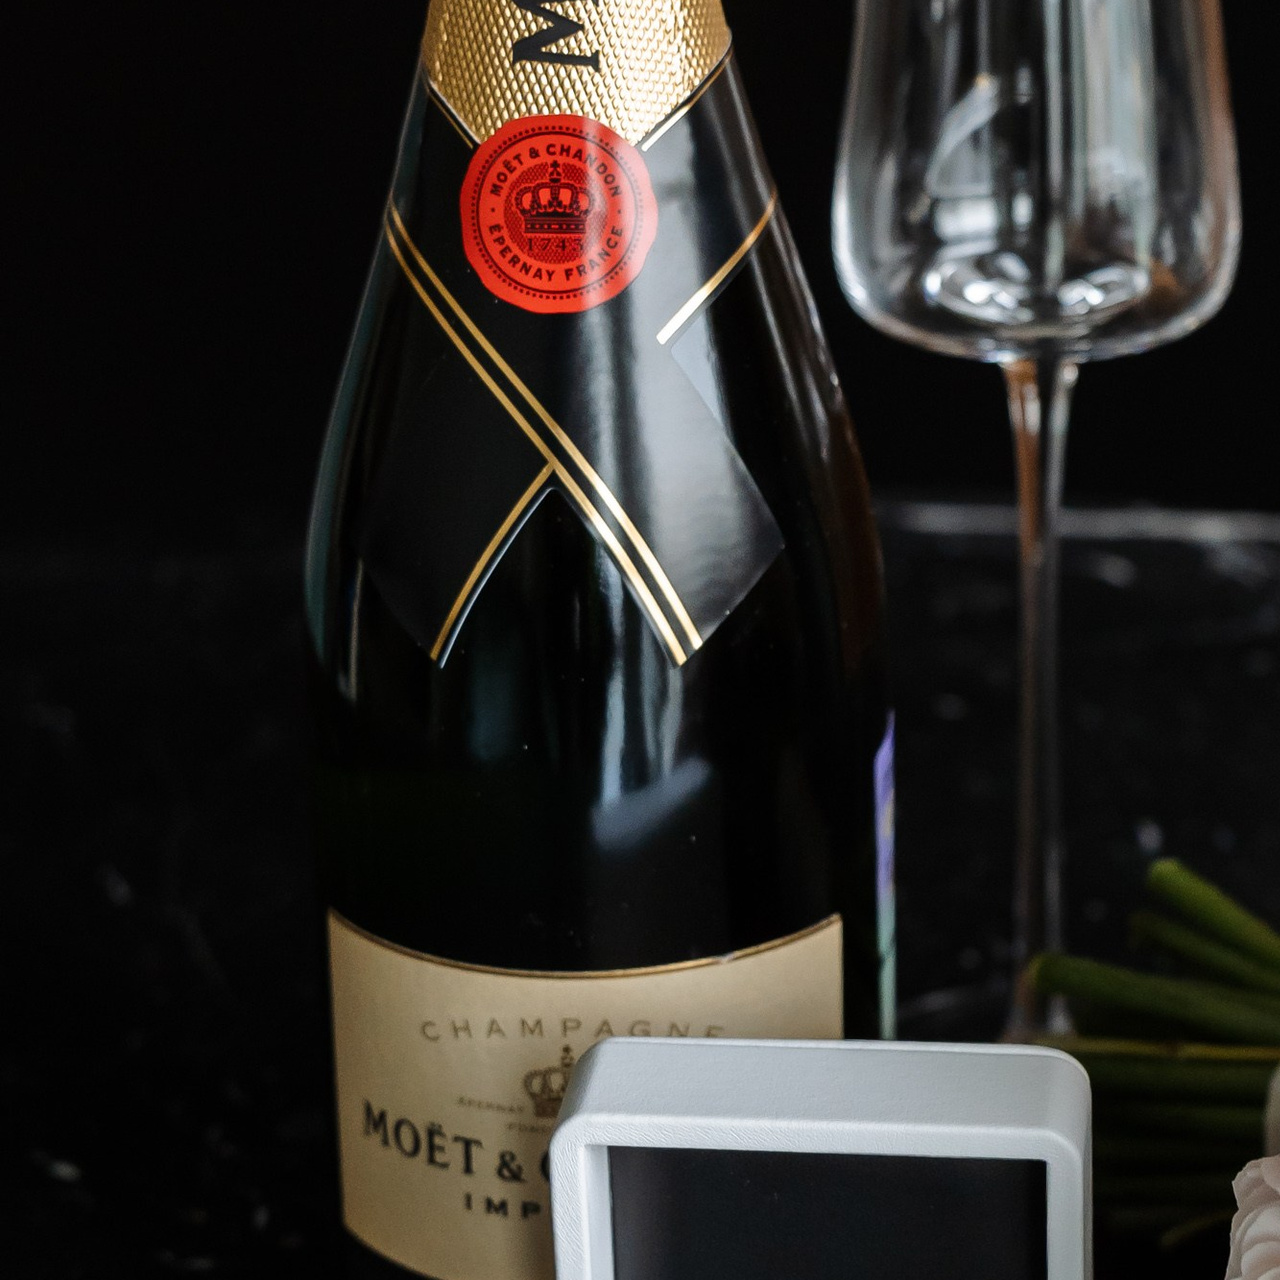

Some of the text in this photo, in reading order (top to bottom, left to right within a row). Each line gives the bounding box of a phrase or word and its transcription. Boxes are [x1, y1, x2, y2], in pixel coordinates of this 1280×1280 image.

[488, 143, 622, 197] MOËT & CHANDON
[489, 223, 623, 282] ÉPERNAY FRANCE
[527, 237, 586, 253] 1743
[421, 1017, 725, 1043] CHAMPAGNE
[363, 1099, 484, 1175] MOËT
[496, 1150, 526, 1183] &
